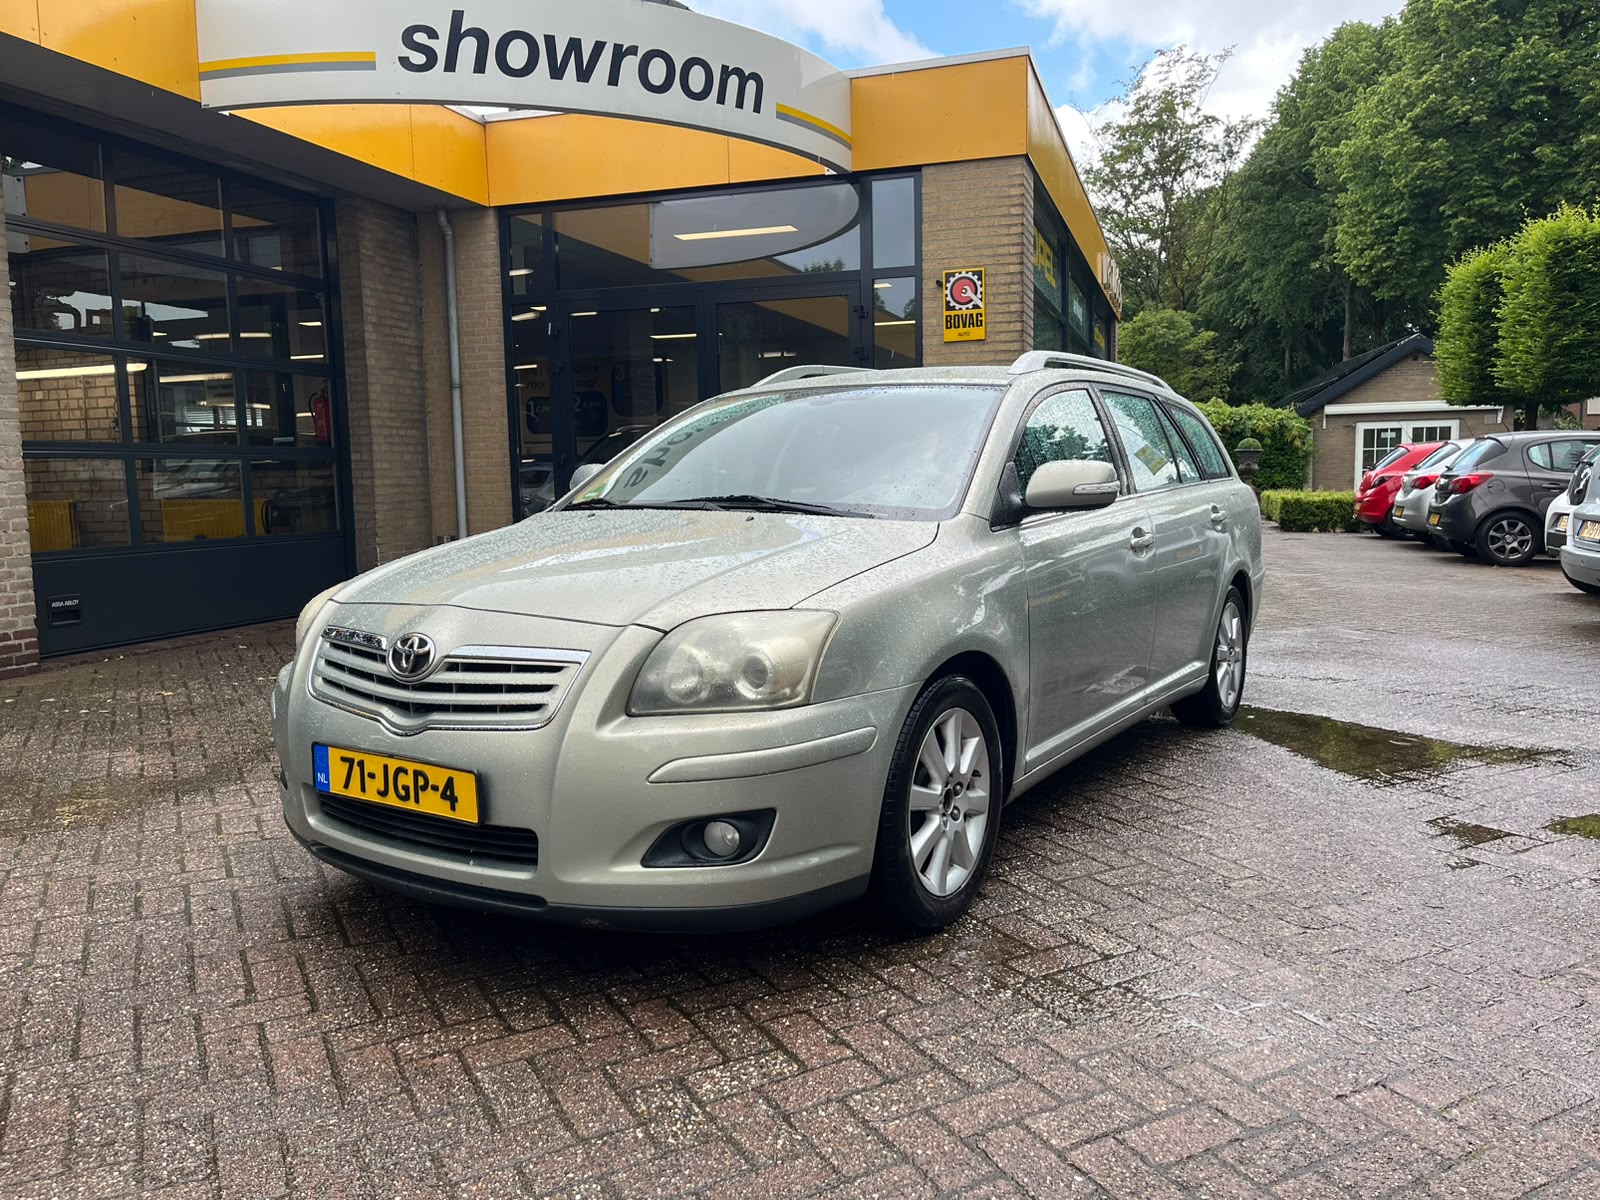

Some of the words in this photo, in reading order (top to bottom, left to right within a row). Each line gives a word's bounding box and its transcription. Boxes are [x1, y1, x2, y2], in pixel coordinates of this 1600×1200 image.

[397, 9, 765, 114] showroom
[945, 313, 983, 330] BOVAG
[317, 772, 328, 784] NL
[340, 756, 458, 812] 71-JGP-4
